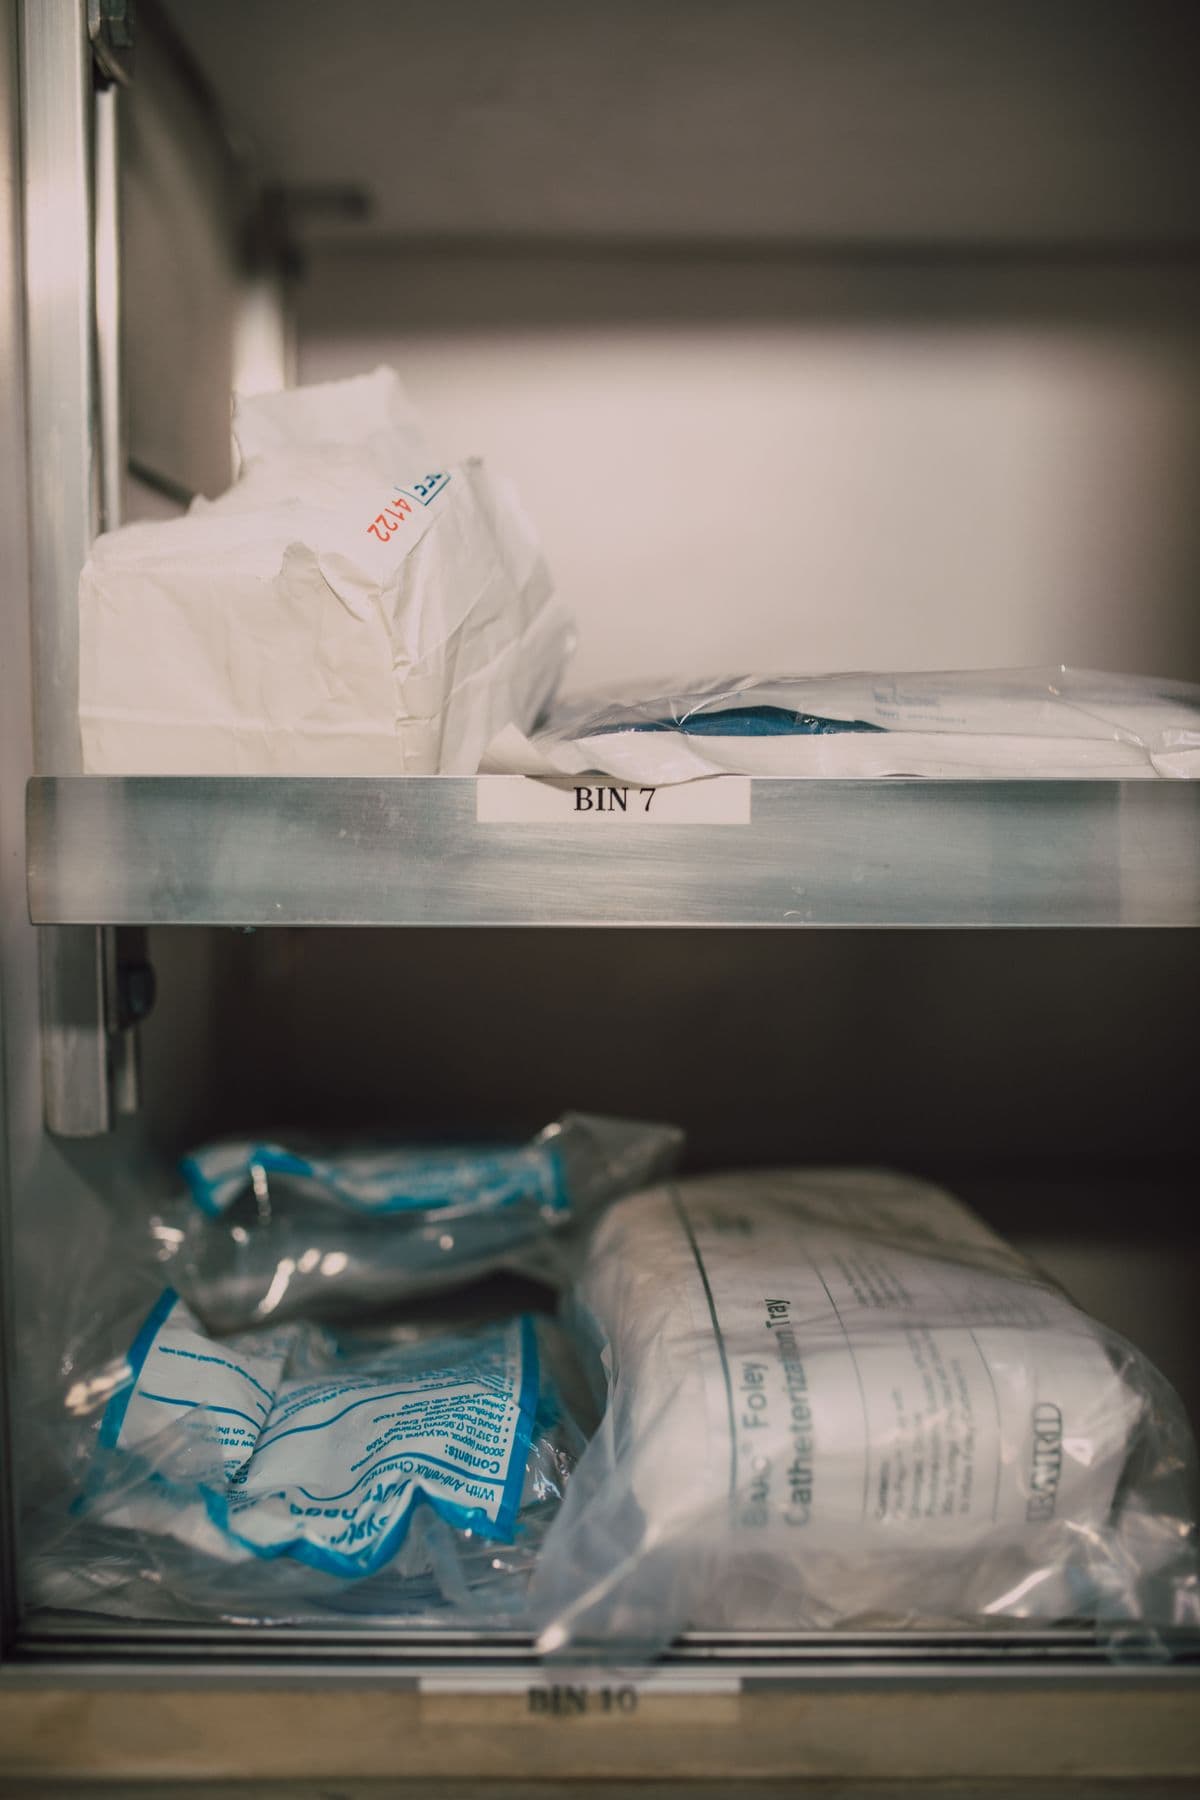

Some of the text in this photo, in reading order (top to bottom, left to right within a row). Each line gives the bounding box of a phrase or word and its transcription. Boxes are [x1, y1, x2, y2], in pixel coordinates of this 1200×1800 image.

[367, 498, 412, 542] 4122
[573, 786, 656, 812] BIN 7
[740, 1362, 768, 1429] Foley
[452, 1413, 477, 1424] Profile
[478, 1418, 501, 1433] Round
[764, 1299, 812, 1527] Catheterization Tray
[444, 1444, 500, 1474] Contents:
[475, 1443, 505, 1457] 2000ml
[415, 1464, 464, 1492] Anti-reflux
[465, 1484, 494, 1501] With
[528, 1685, 639, 1715] BIN 10
